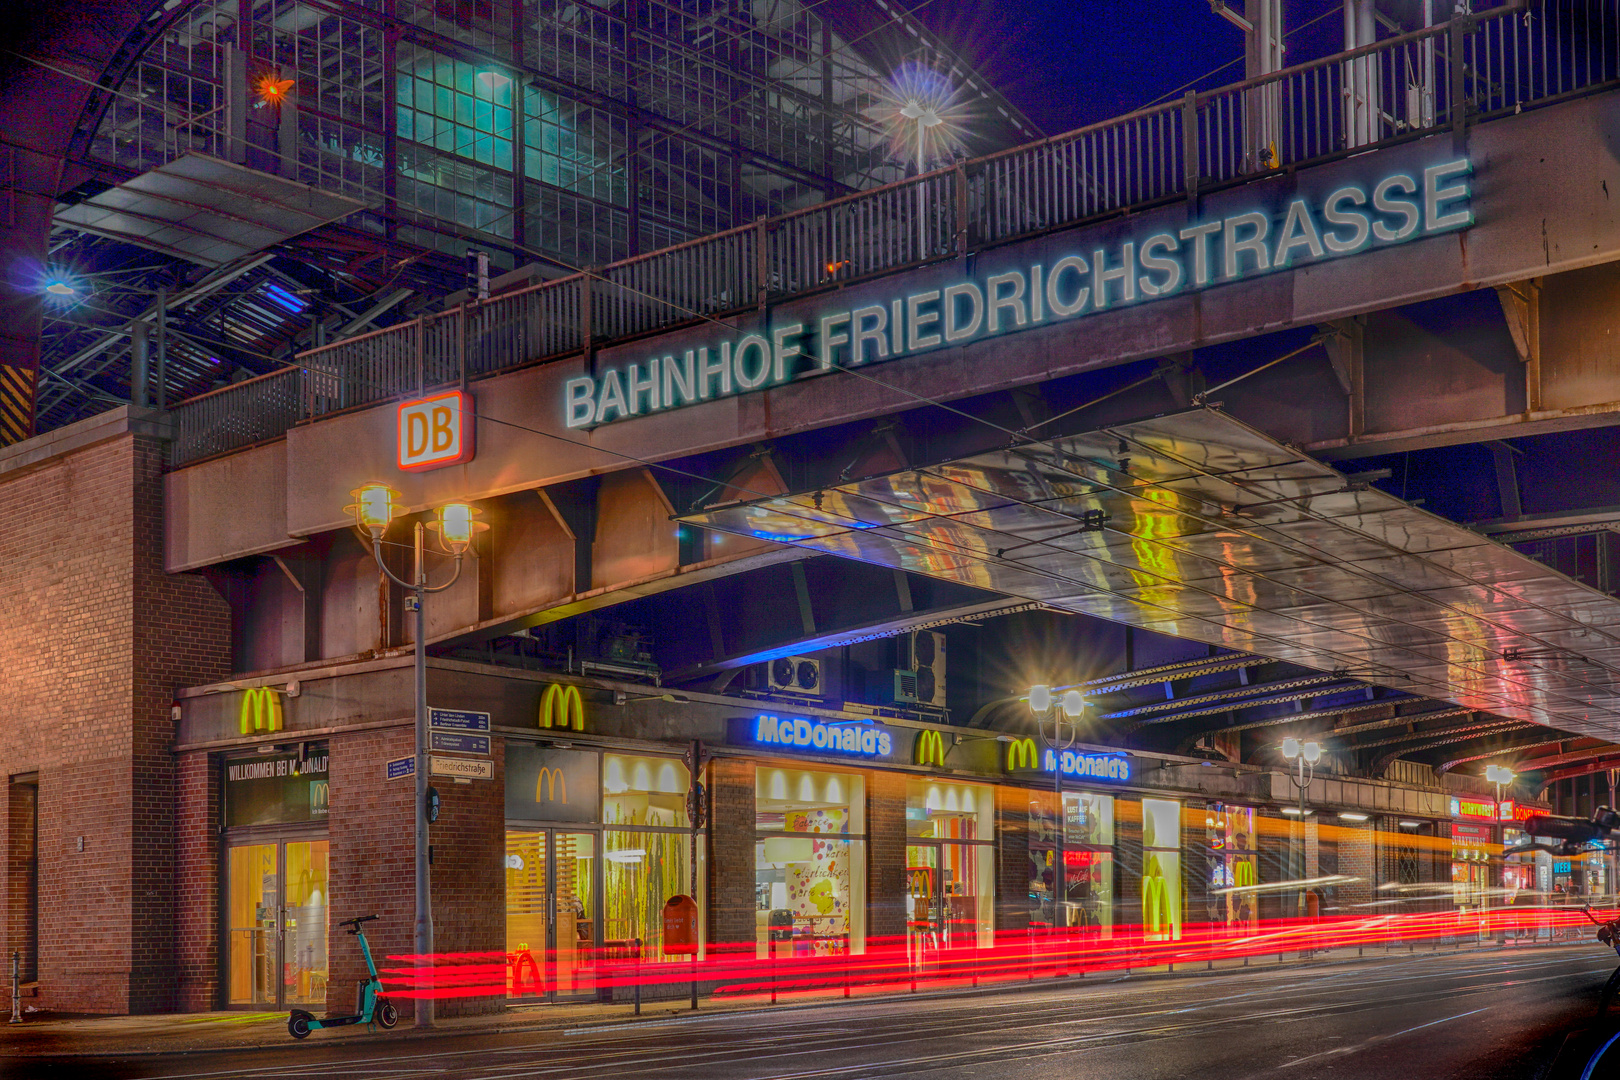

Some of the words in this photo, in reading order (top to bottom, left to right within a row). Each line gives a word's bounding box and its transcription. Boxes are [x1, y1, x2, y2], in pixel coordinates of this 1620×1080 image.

[566, 322, 804, 429] BAHNHOF
[819, 158, 1473, 370] FRIEDRICHSTRASSE
[407, 406, 453, 458] DB
[757, 715, 891, 755] McDonald's
[229, 762, 275, 781] WILLKOMMEN
[276, 760, 287, 777] BEI
[436, 759, 486, 775] Friedrichstraße
[1067, 805, 1078, 813] LUST
